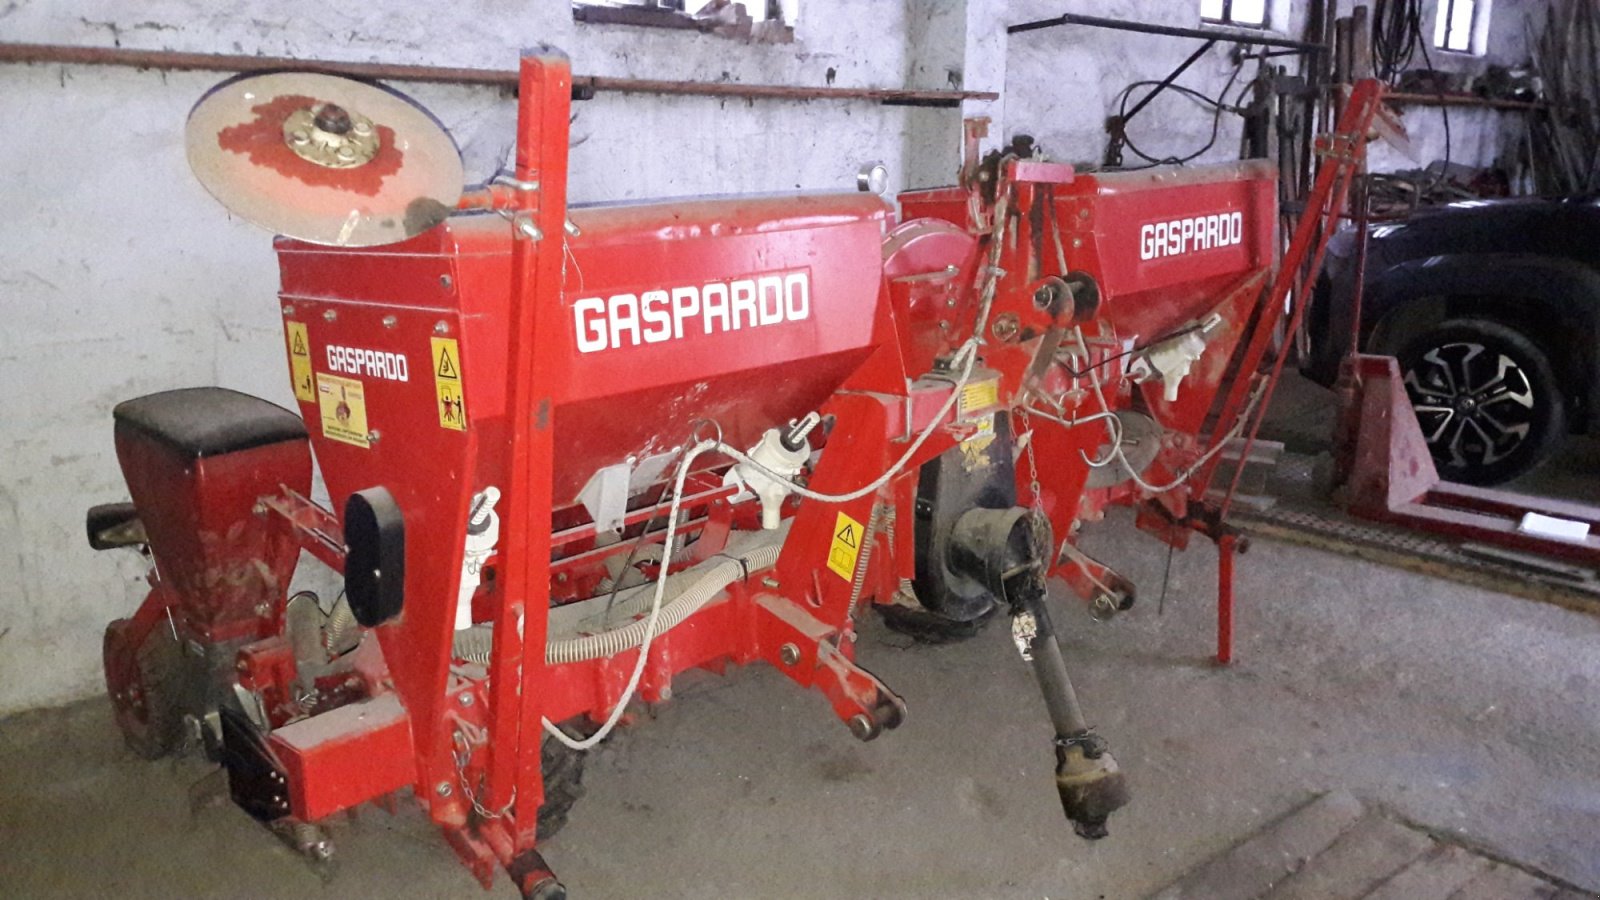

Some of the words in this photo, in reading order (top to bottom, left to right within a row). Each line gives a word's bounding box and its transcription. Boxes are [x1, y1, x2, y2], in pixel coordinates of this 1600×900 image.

[1141, 212, 1242, 260] GASPARDO
[574, 272, 810, 353] GASPARDO
[326, 345, 409, 382] GASPARDO
